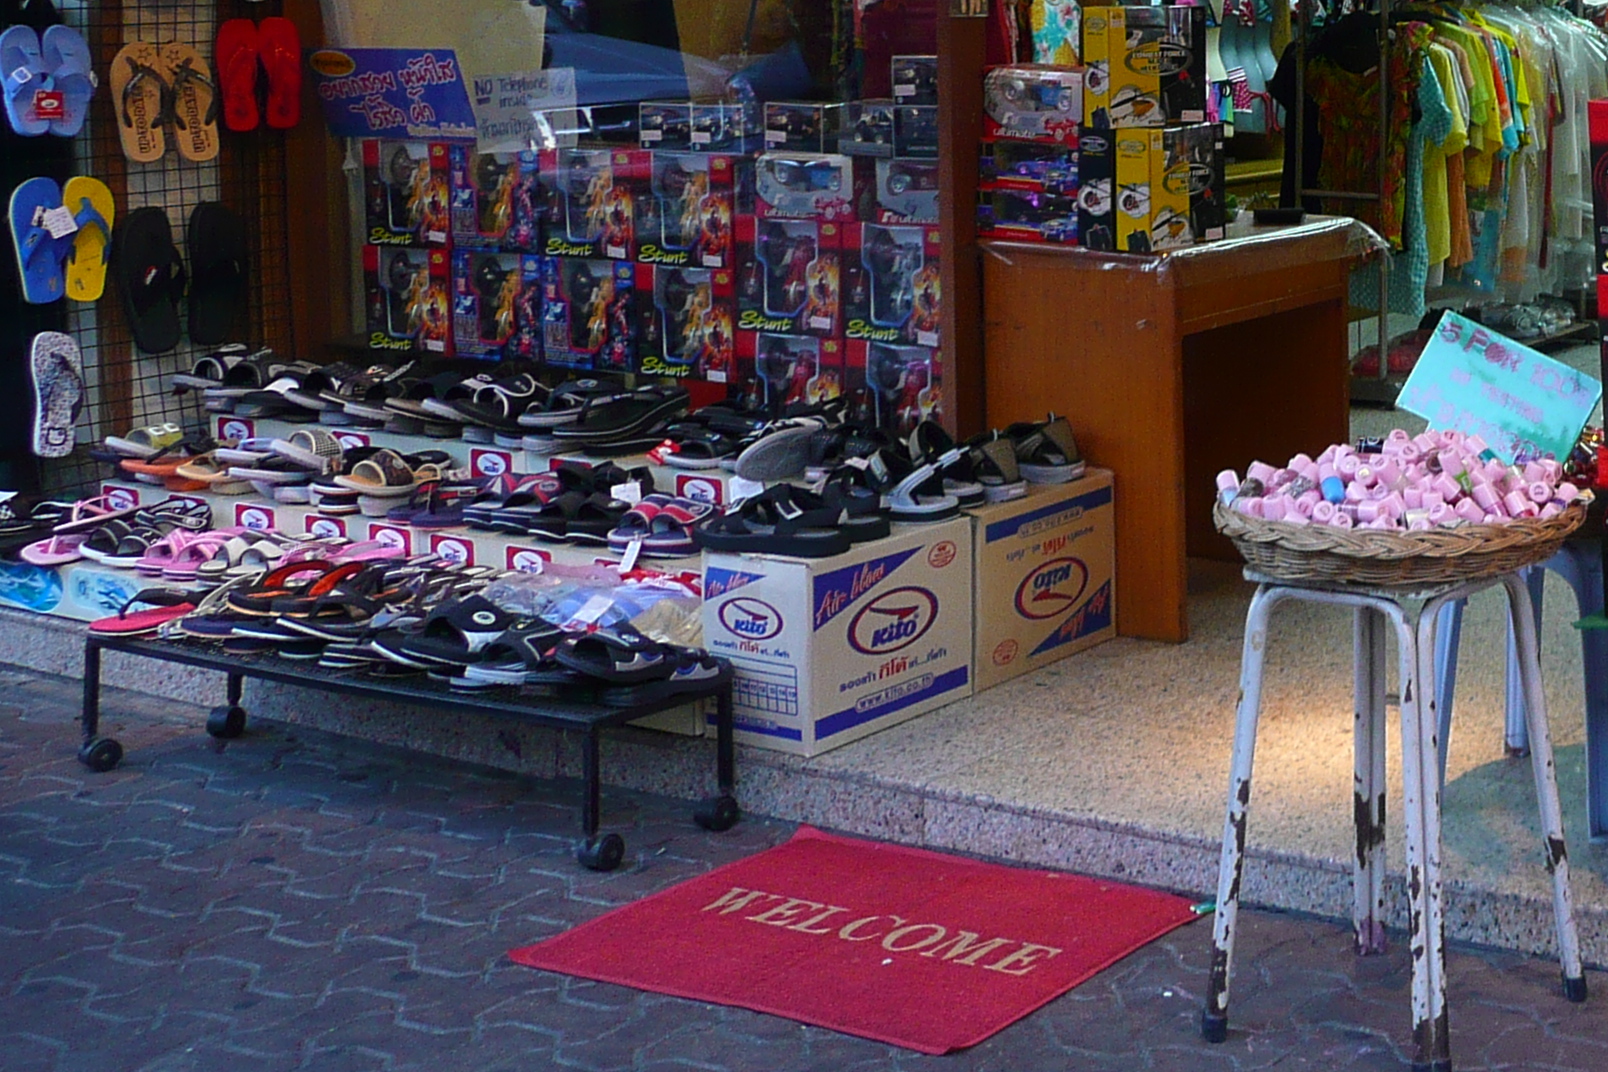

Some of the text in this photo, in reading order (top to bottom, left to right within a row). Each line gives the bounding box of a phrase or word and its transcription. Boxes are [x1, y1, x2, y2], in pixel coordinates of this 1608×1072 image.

[474, 78, 493, 97] NO
[369, 227, 413, 245] Stunt
[545, 238, 593, 257] Stunt
[638, 245, 689, 264] Stunt
[739, 310, 792, 332] Stunt
[846, 318, 898, 342] Stunt
[369, 332, 412, 351] Stunt
[1440, 322, 1464, 343] 5
[1462, 330, 1526, 373] FOR
[640, 356, 690, 378] Stunt
[1033, 563, 1071, 590] Kito
[816, 589, 847, 625] Air
[733, 618, 768, 635] Kito
[871, 619, 918, 649] Kito
[879, 656, 909, 679] กีโต้
[858, 673, 933, 709] www.kito.co.th
[701, 886, 1063, 976] WELCOME
